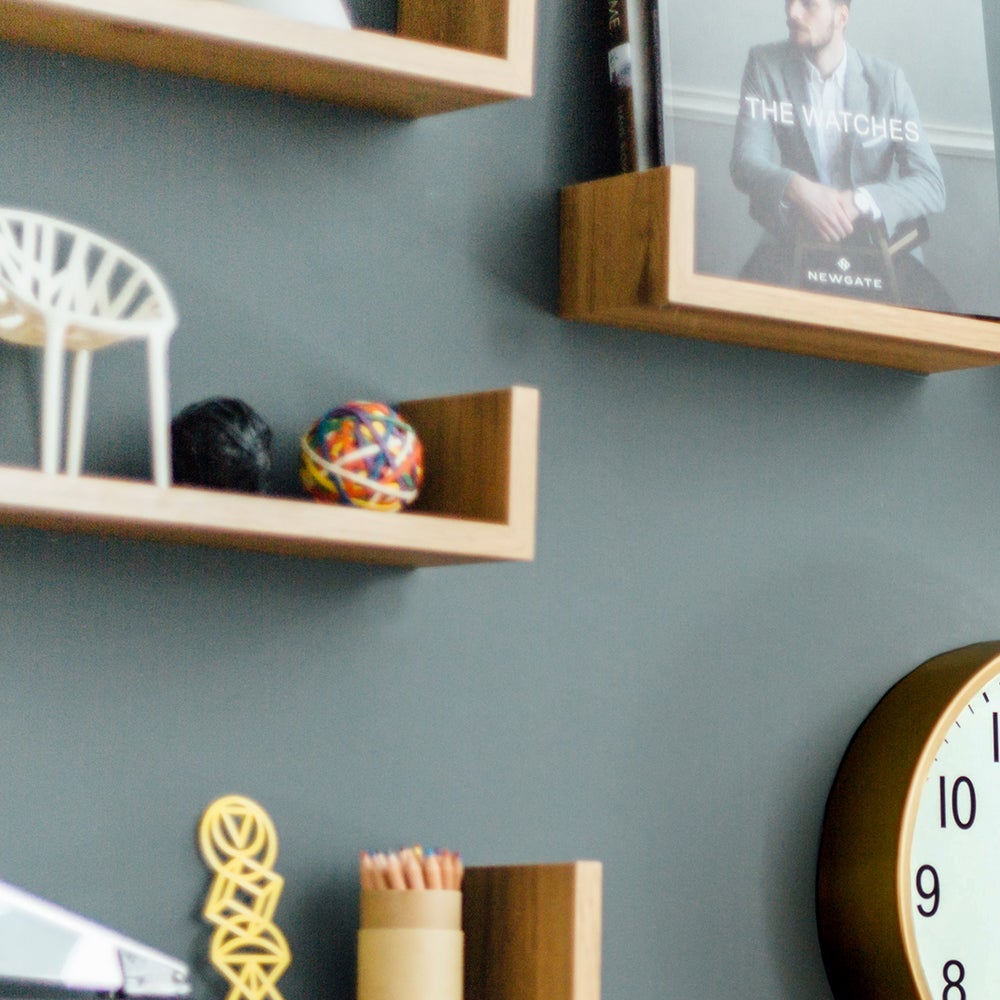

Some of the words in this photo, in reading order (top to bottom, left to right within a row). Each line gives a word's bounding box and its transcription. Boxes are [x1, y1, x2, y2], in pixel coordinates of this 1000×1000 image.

[745, 96, 794, 125] THE
[802, 105, 920, 142] WATCHES
[807, 270, 882, 289] NEWGATE
[939, 775, 977, 830] 10
[915, 864, 940, 918] 9
